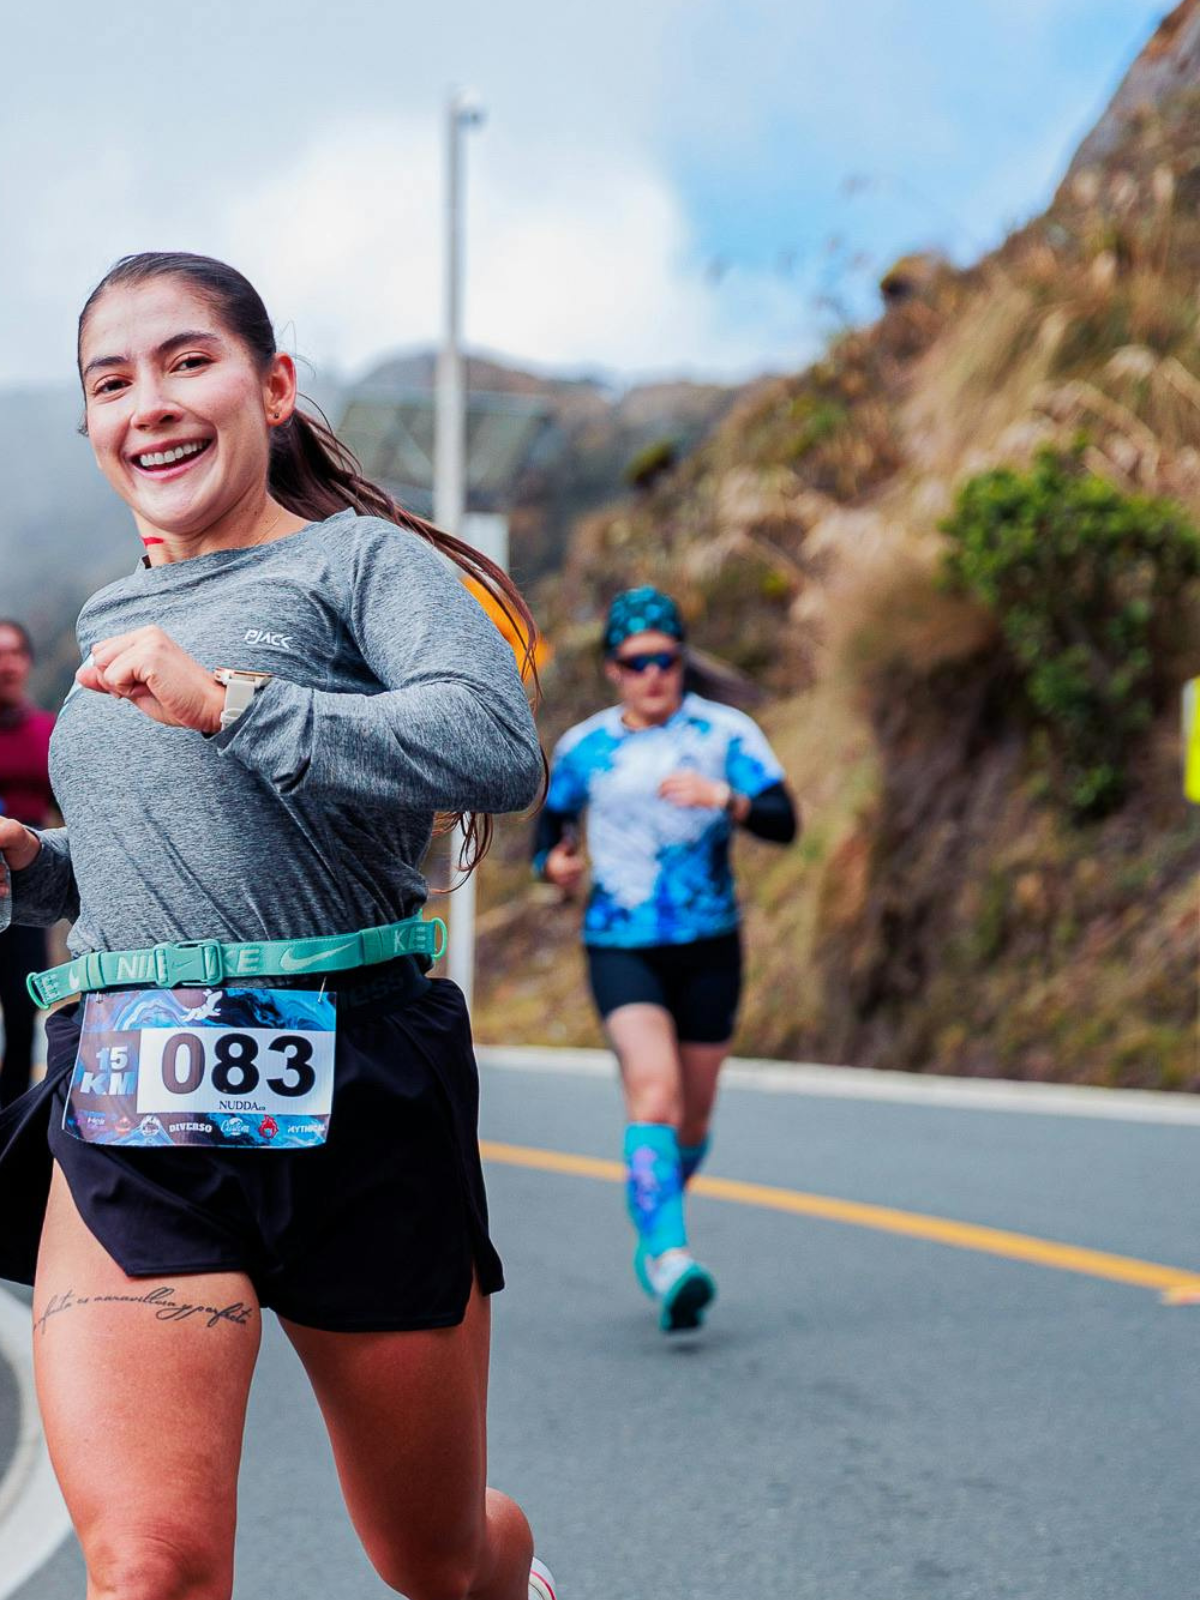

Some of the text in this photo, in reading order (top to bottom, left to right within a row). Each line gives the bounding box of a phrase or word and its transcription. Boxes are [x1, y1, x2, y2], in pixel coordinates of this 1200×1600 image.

[96, 1046, 128, 1070] 15
[162, 1032, 316, 1097] 083
[80, 1071, 135, 1096] KM
[167, 1122, 212, 1133] DIVERSO
